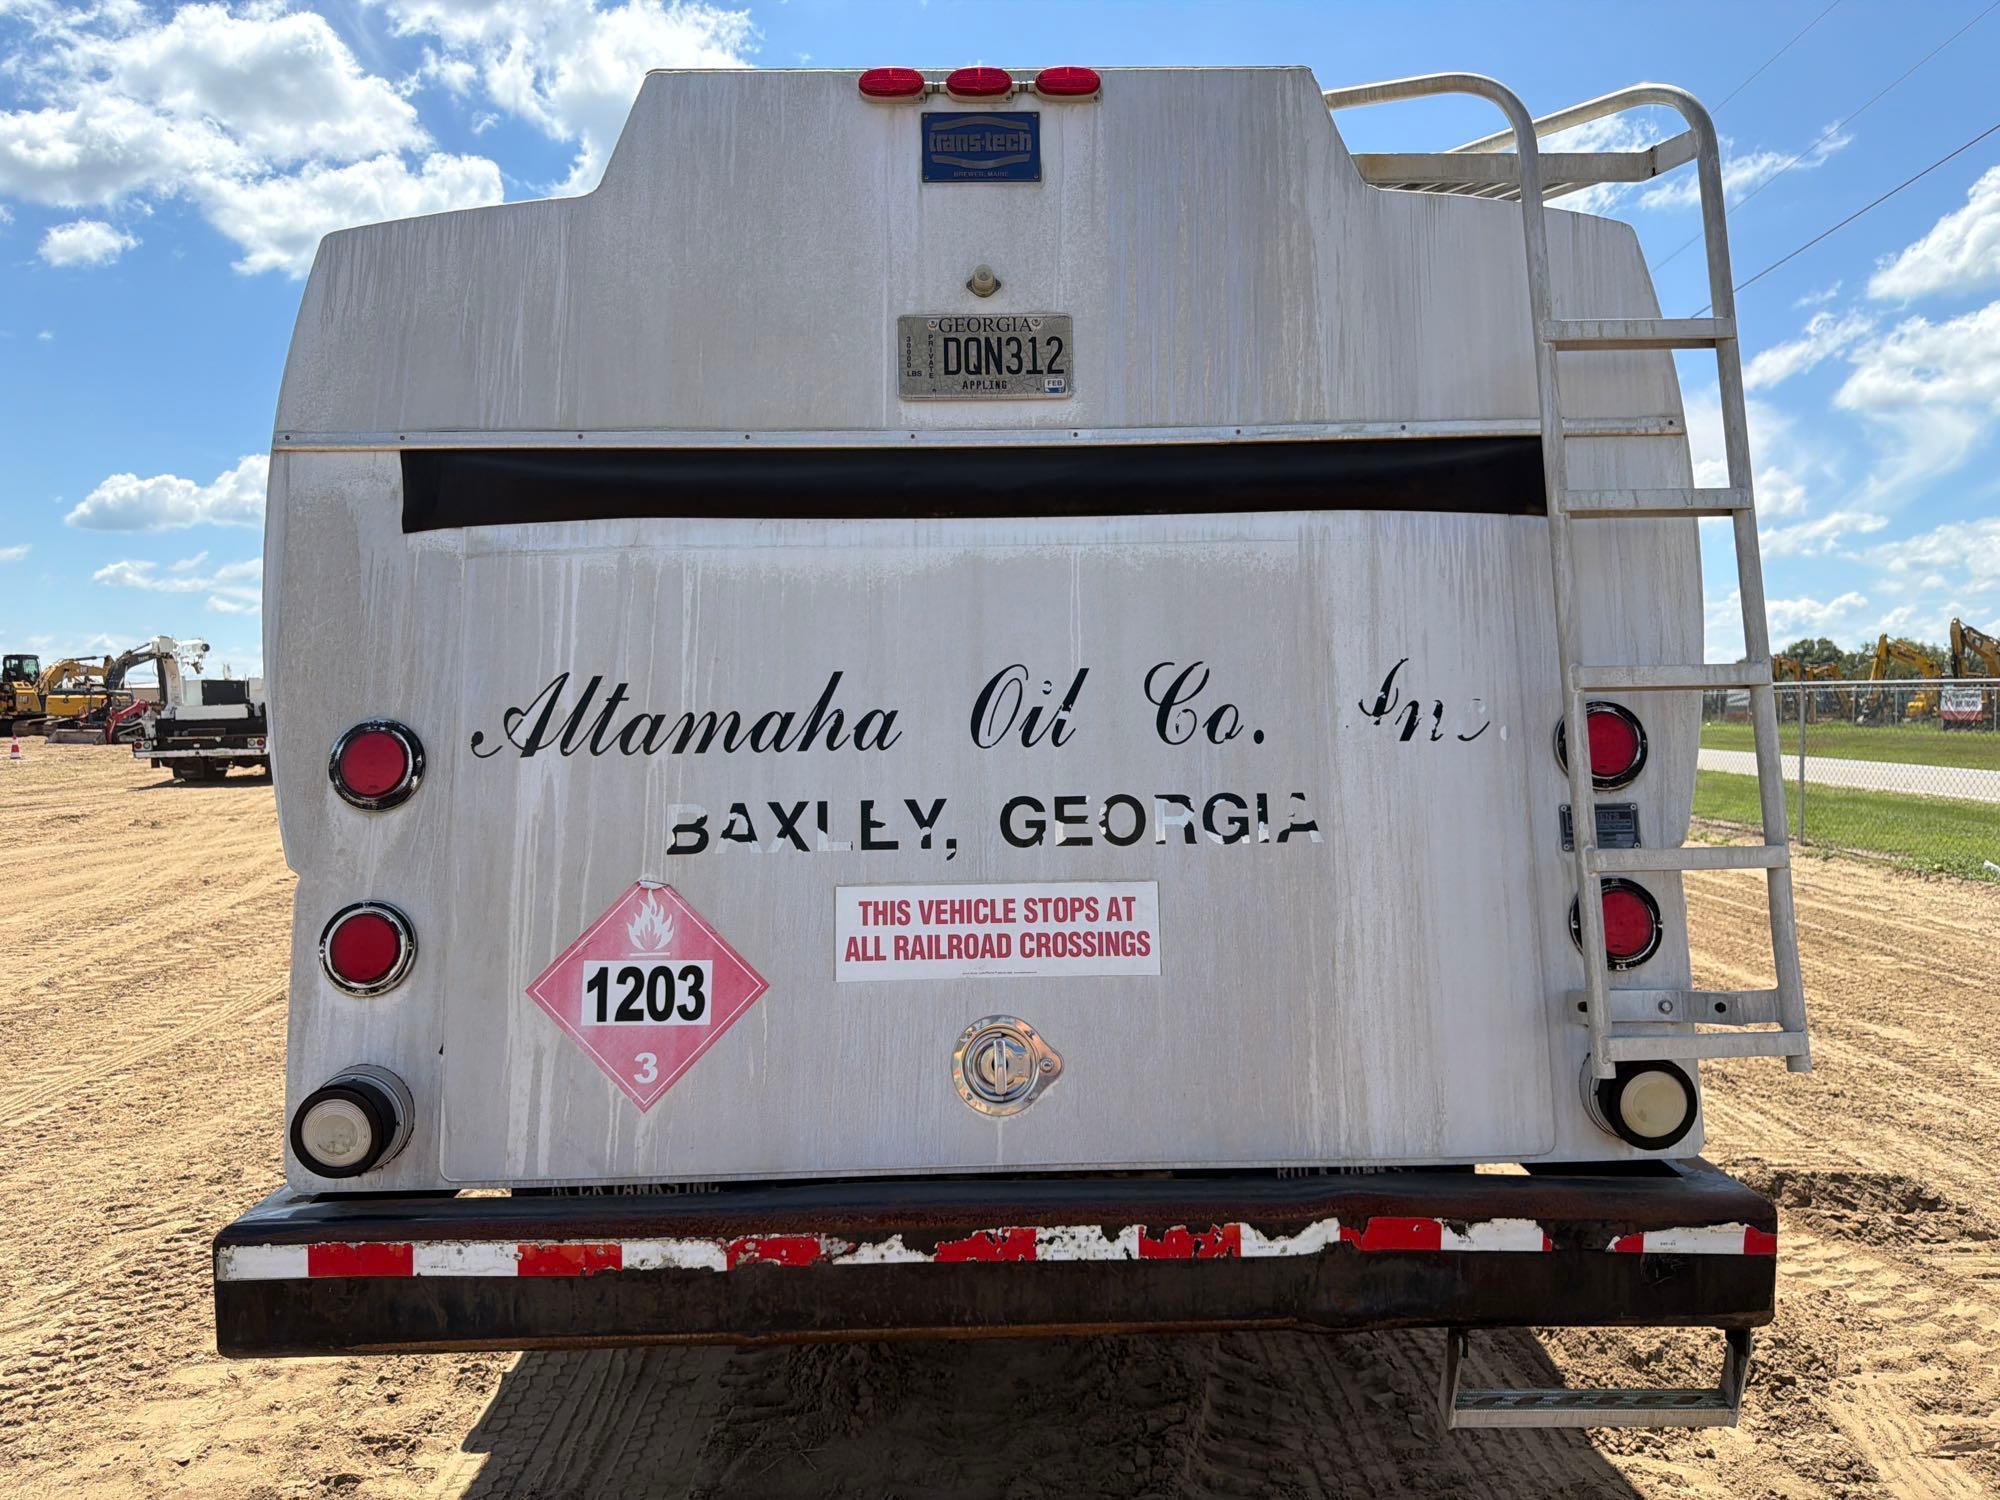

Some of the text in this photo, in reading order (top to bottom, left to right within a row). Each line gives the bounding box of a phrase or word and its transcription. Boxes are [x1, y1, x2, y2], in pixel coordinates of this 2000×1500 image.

[938, 317, 1034, 333] GEORGIA
[943, 336, 1066, 376] DQN312
[962, 380, 1008, 390] APPLING
[471, 671, 903, 758] Altamaha
[970, 663, 1090, 749] Oil
[1144, 661, 1265, 745] Co.
[666, 792, 1323, 861] BAXLEY, GEORGIA
[858, 896, 1136, 926] THIS VEHICLE STOPS AT
[845, 930, 1152, 962] ALL RAILROAD CROSSINGS
[587, 964, 706, 1023] 1203
[634, 1052, 658, 1084] 3
